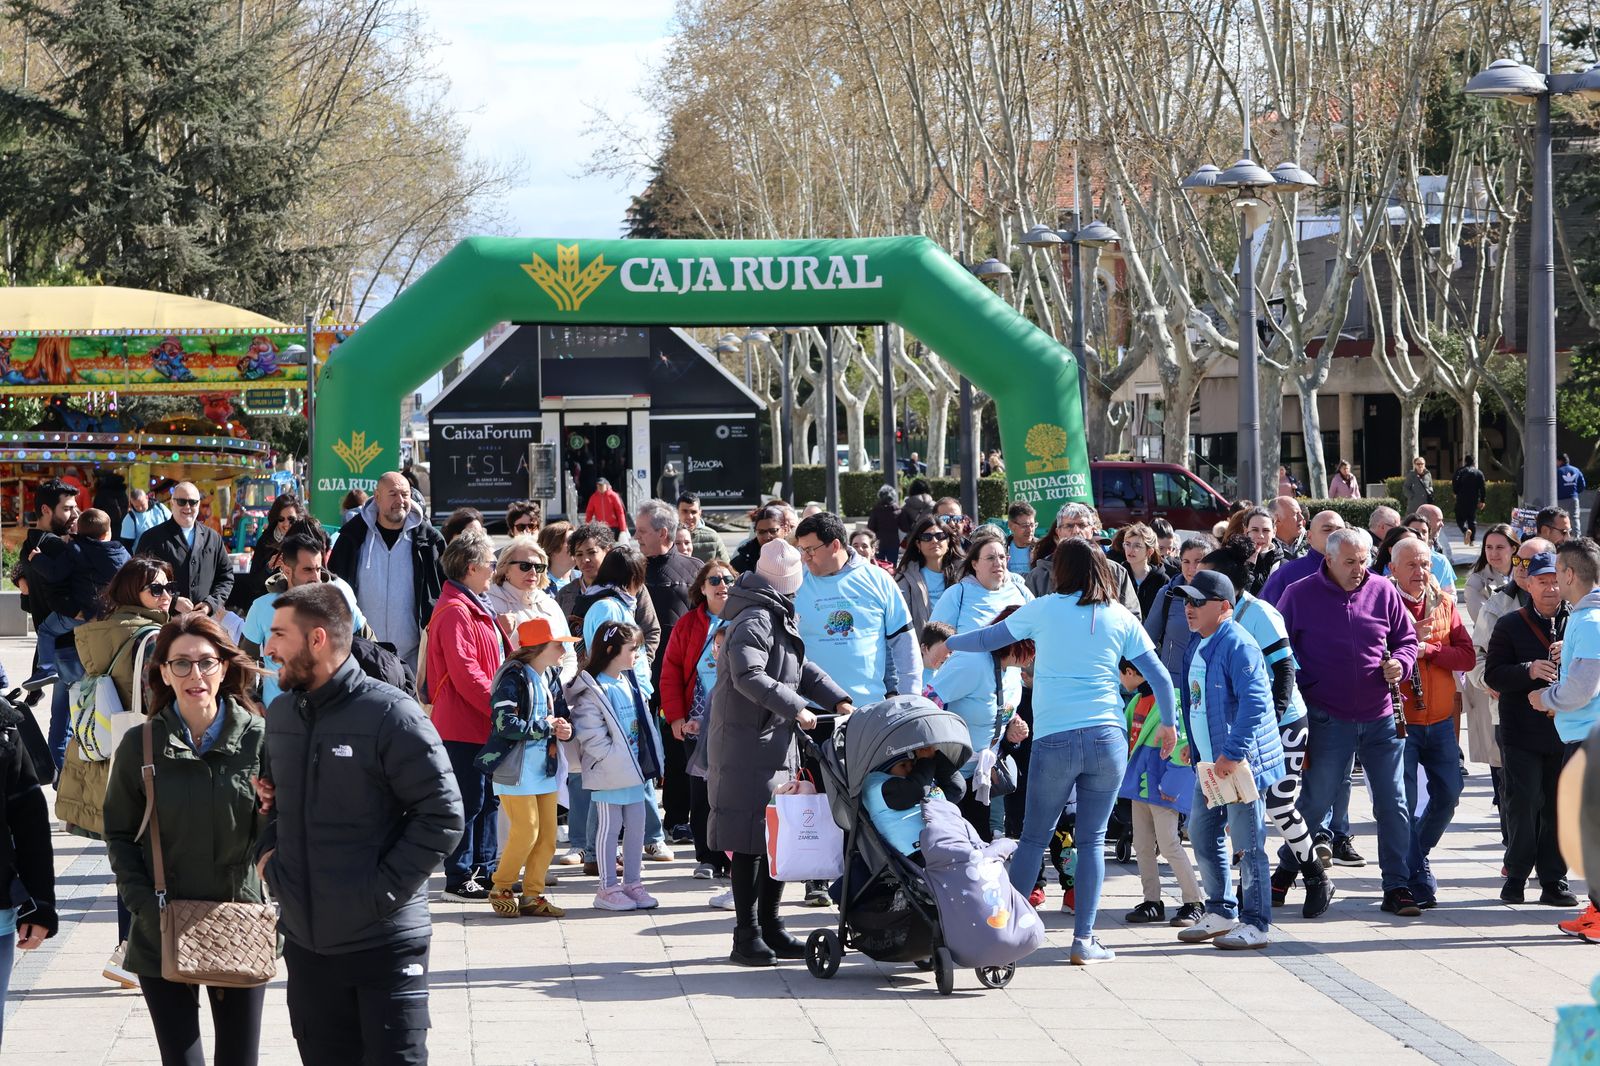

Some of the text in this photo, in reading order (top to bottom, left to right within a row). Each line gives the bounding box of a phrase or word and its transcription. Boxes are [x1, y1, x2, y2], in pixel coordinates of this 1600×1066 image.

[620, 254, 883, 295] CAJA RURAL
[441, 425, 532, 440] CaixaForum
[449, 453, 530, 475] TESLA
[317, 477, 378, 492] CAJA RUR
[1013, 473, 1087, 493] FUNDACION
[1014, 486, 1087, 503] CAJA RURAL
